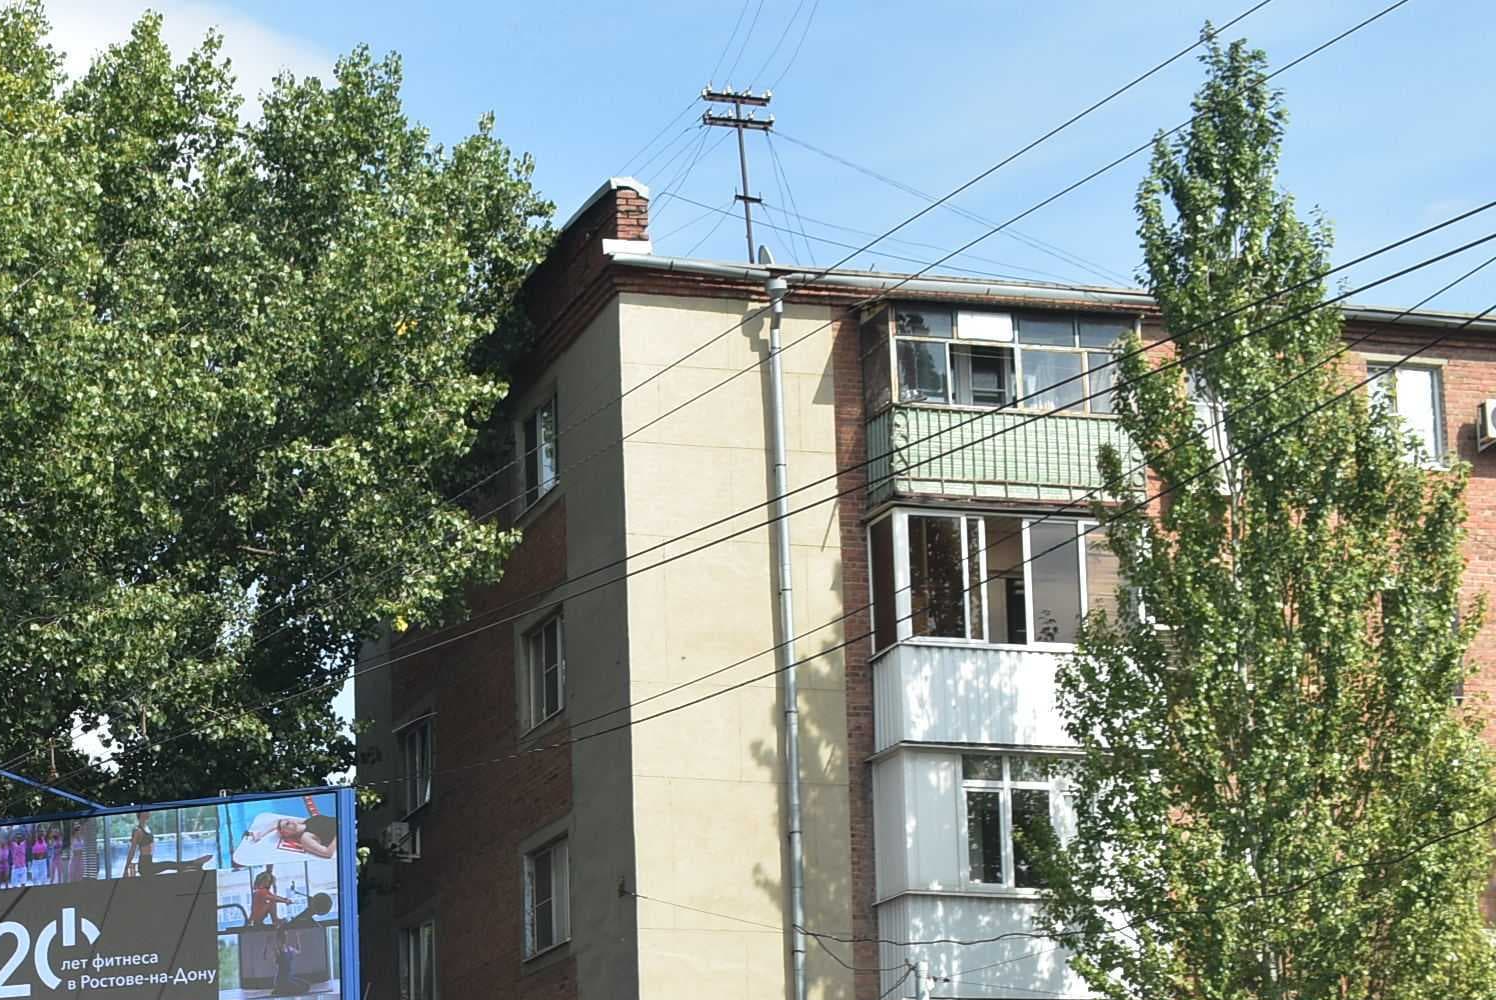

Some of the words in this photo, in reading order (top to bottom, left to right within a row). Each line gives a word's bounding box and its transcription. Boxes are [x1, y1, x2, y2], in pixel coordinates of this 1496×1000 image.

[60, 959, 89, 971] лет
[92, 953, 160, 972] фитнеса
[67, 980, 76, 991] в
[80, 969, 217, 989] Ростове-на-Дону
